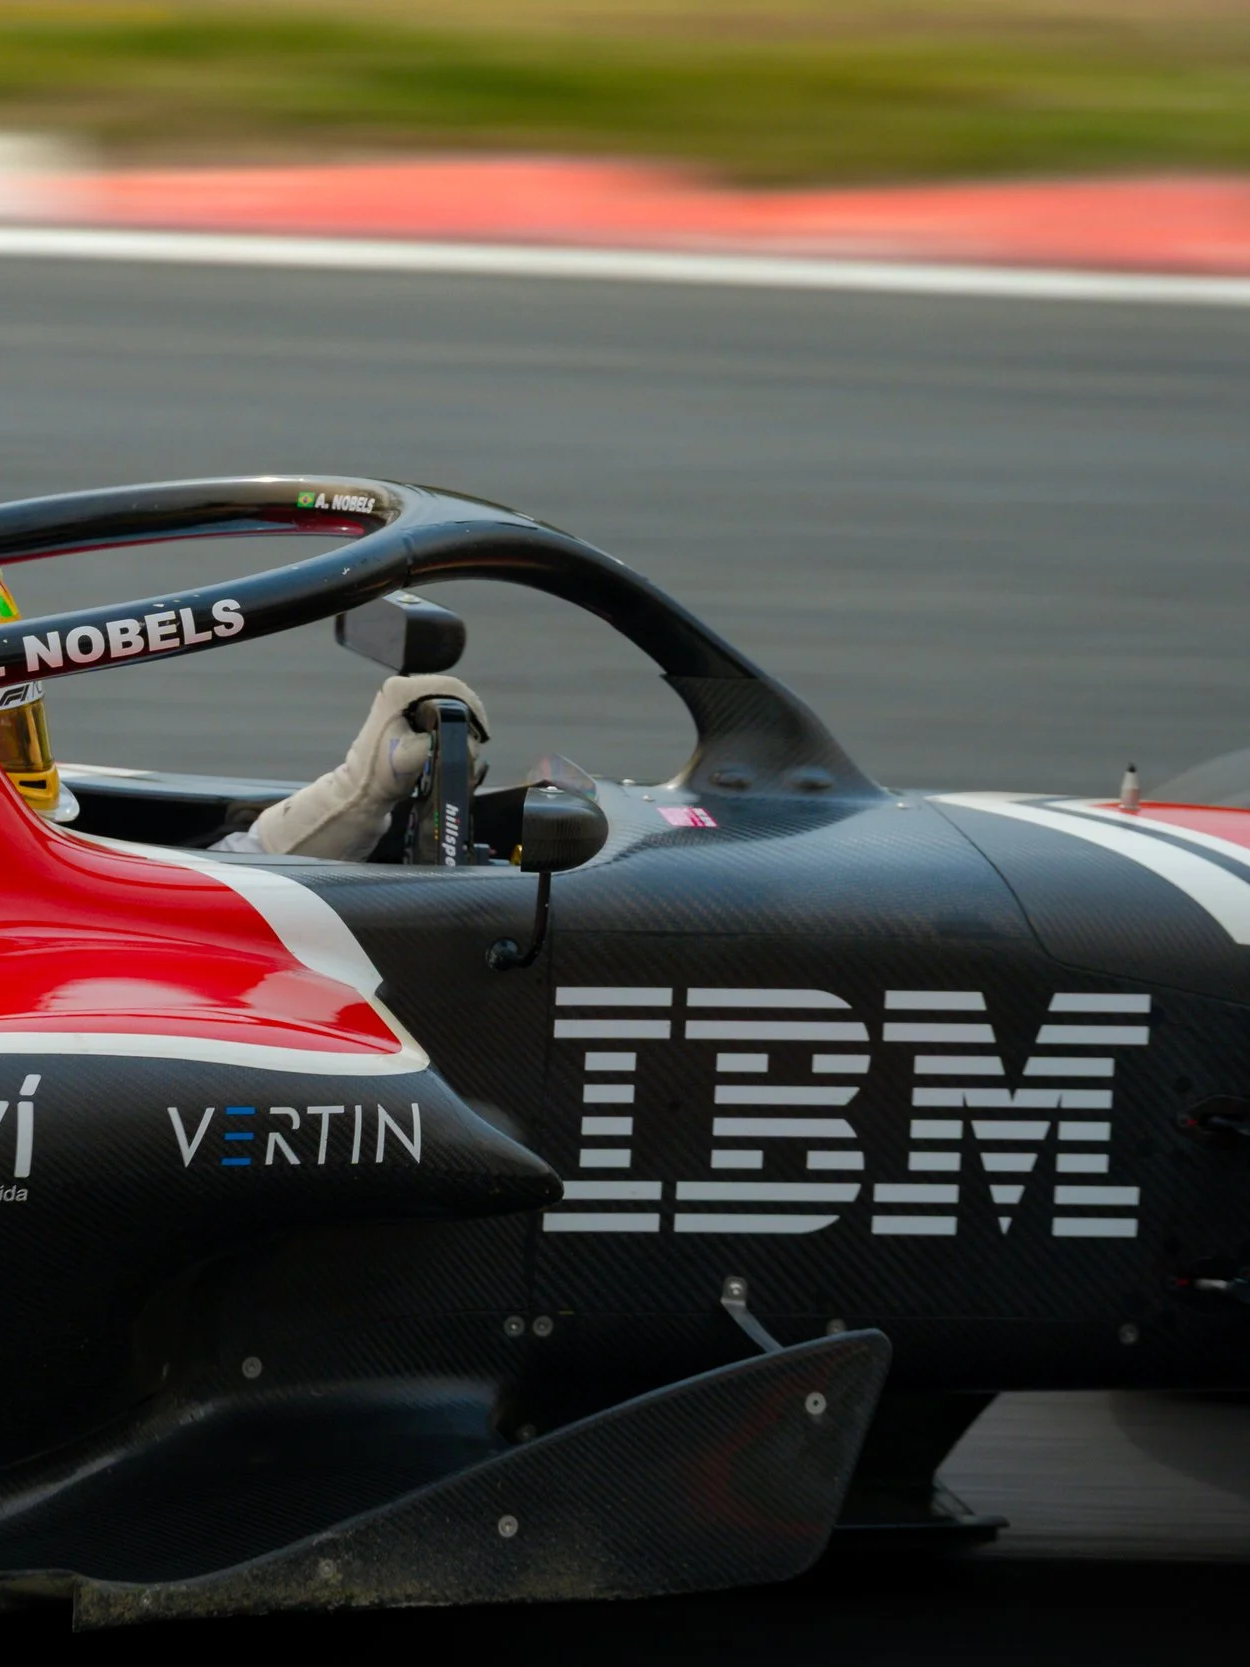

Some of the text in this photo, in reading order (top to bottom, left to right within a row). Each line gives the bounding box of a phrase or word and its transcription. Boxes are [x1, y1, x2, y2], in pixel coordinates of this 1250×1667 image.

[332, 494, 376, 513] NOBELS
[22, 598, 246, 674] NOBELS
[167, 1102, 423, 1168] VERTIN
[543, 986, 1152, 1238] IBM
